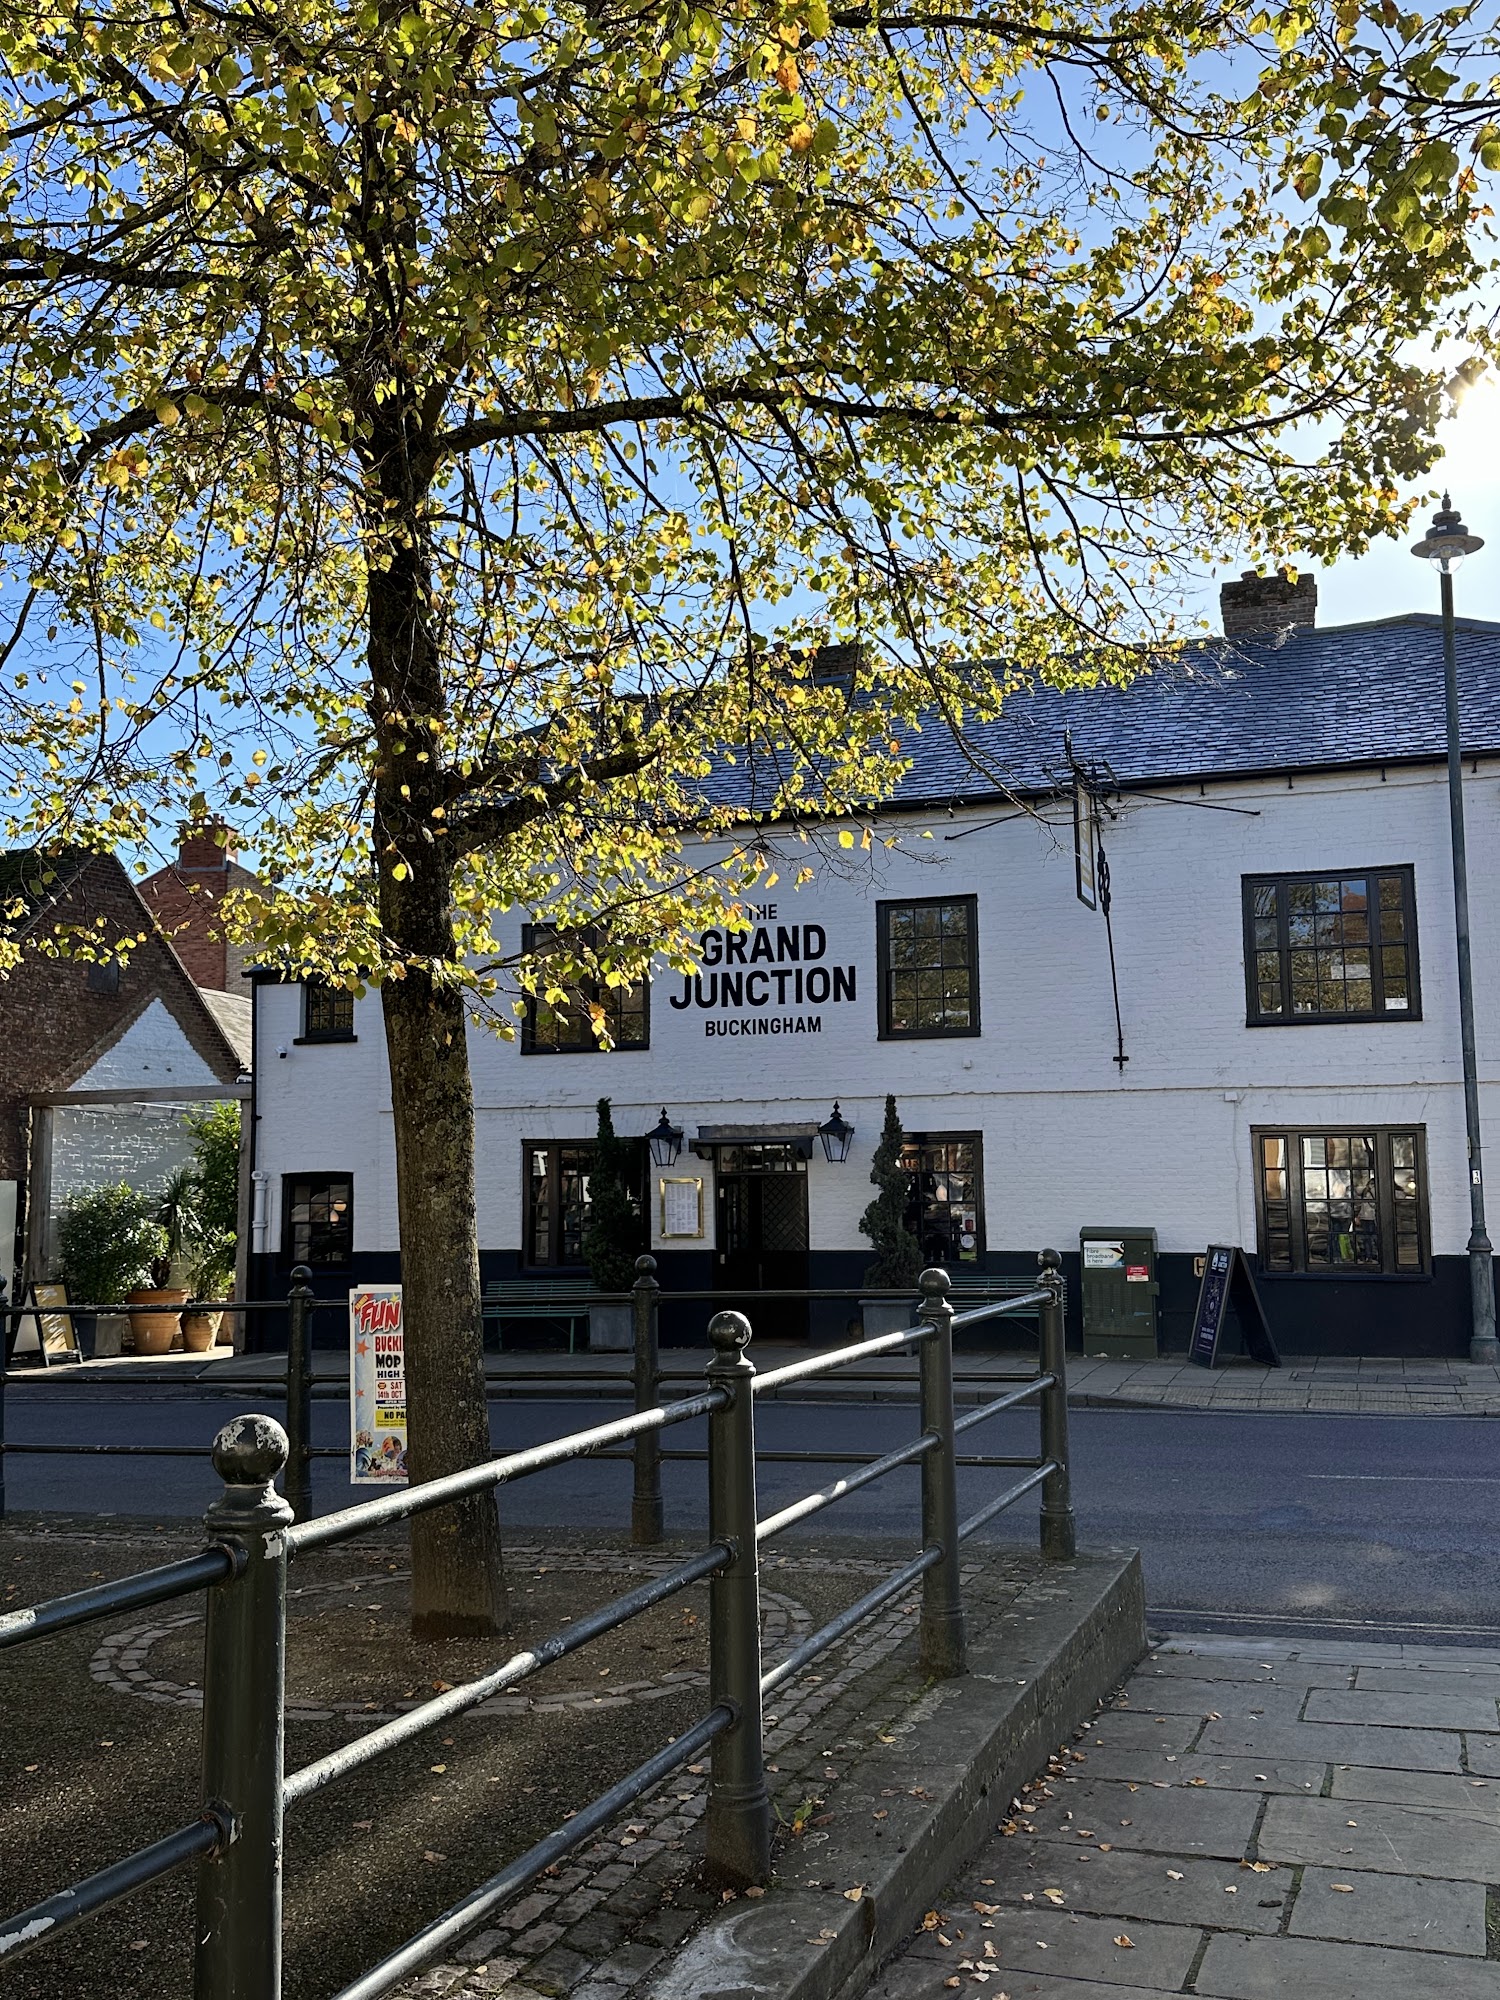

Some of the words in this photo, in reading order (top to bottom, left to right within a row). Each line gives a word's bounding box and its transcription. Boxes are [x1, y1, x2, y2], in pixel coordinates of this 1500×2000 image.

[746, 904, 777, 920] THE
[700, 924, 827, 966] GRAND
[670, 966, 856, 1010] JUNCTION
[705, 1016, 821, 1036] BUCKINGHAM
[360, 1298, 401, 1333] FUN
[375, 1336, 402, 1352] BUCKI
[376, 1354, 401, 1368] MOP
